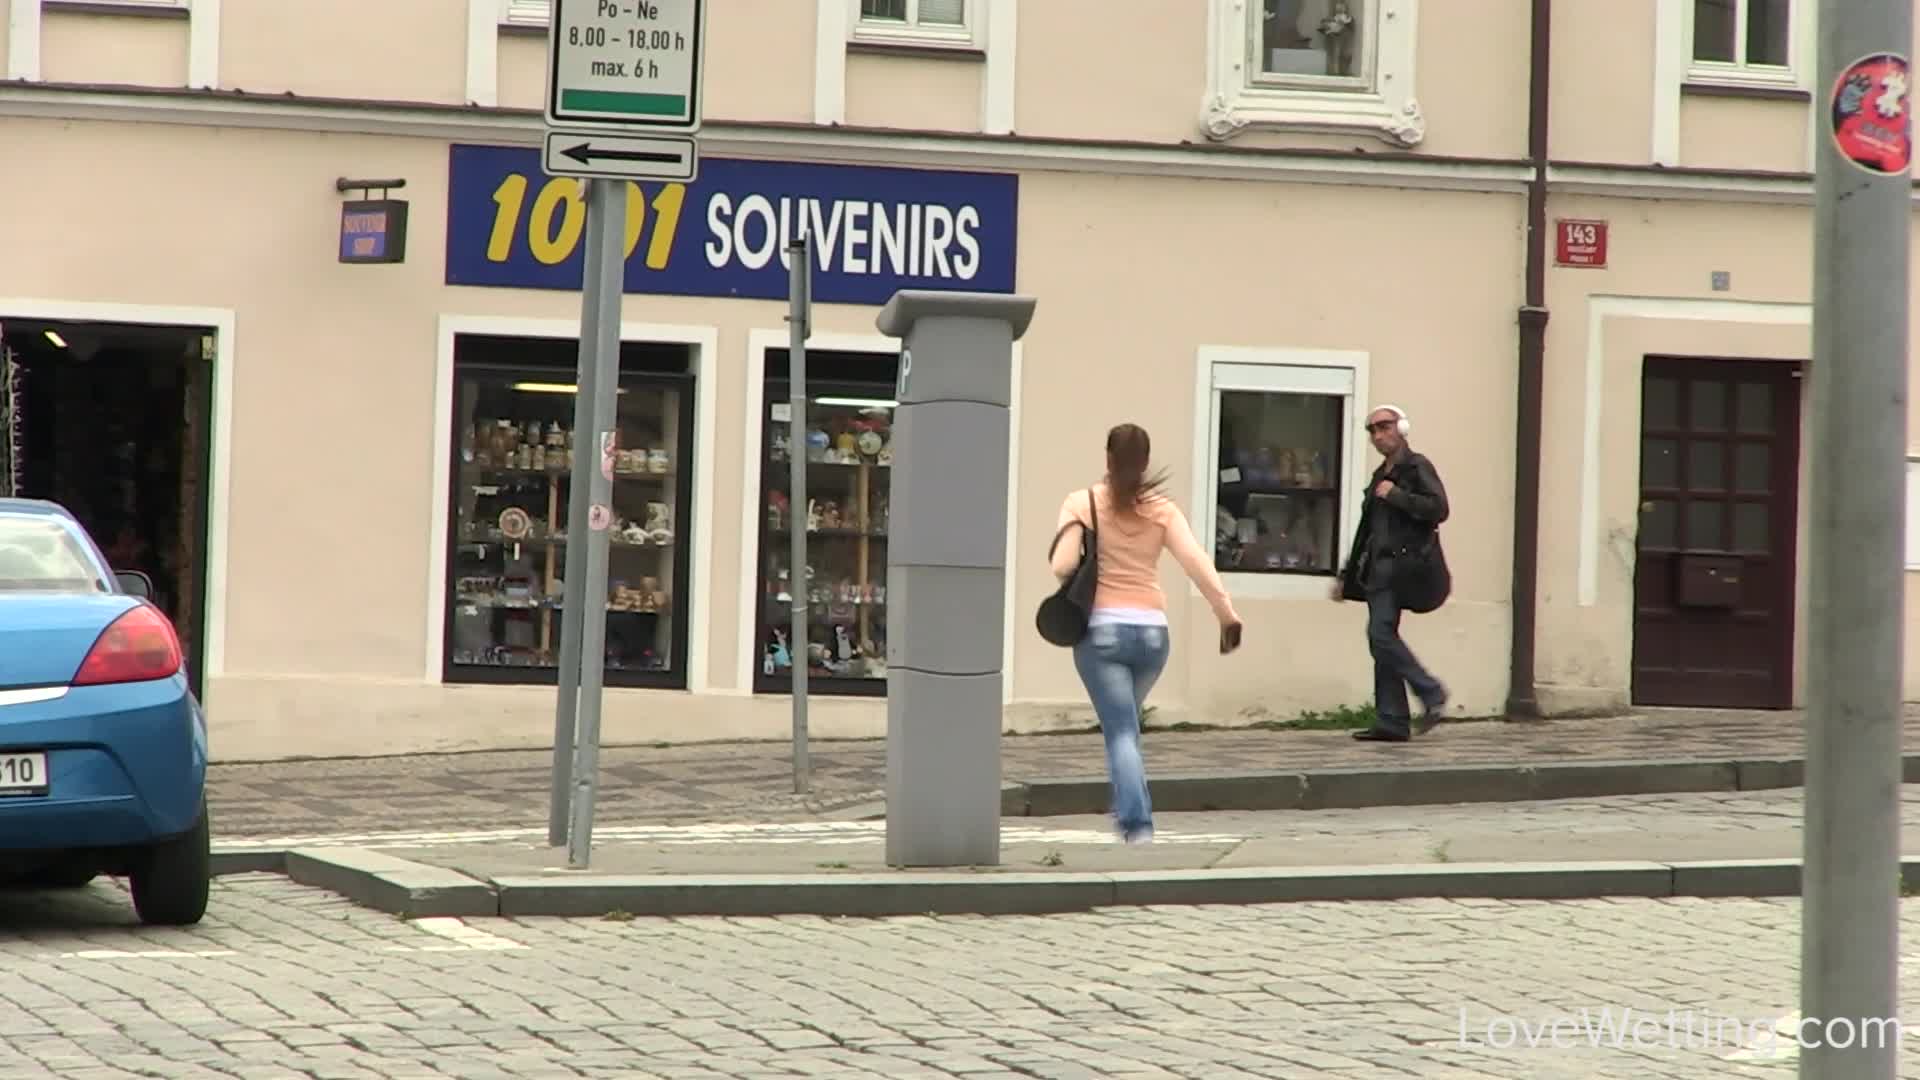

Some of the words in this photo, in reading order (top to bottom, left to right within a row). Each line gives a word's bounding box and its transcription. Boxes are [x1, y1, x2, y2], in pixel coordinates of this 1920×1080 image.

[597, 0, 618, 18] Po
[637, 0, 658, 20] Ne
[569, 26, 606, 47] 8.00
[628, 29, 670, 50] 18.00
[675, 32, 685, 51] h
[591, 61, 628, 77] max.
[634, 58, 643, 78] 6
[649, 59, 658, 78] h
[705, 192, 980, 280] SOUVENIRS
[1566, 224, 1596, 244] 143
[0, 758, 33, 783] 10
